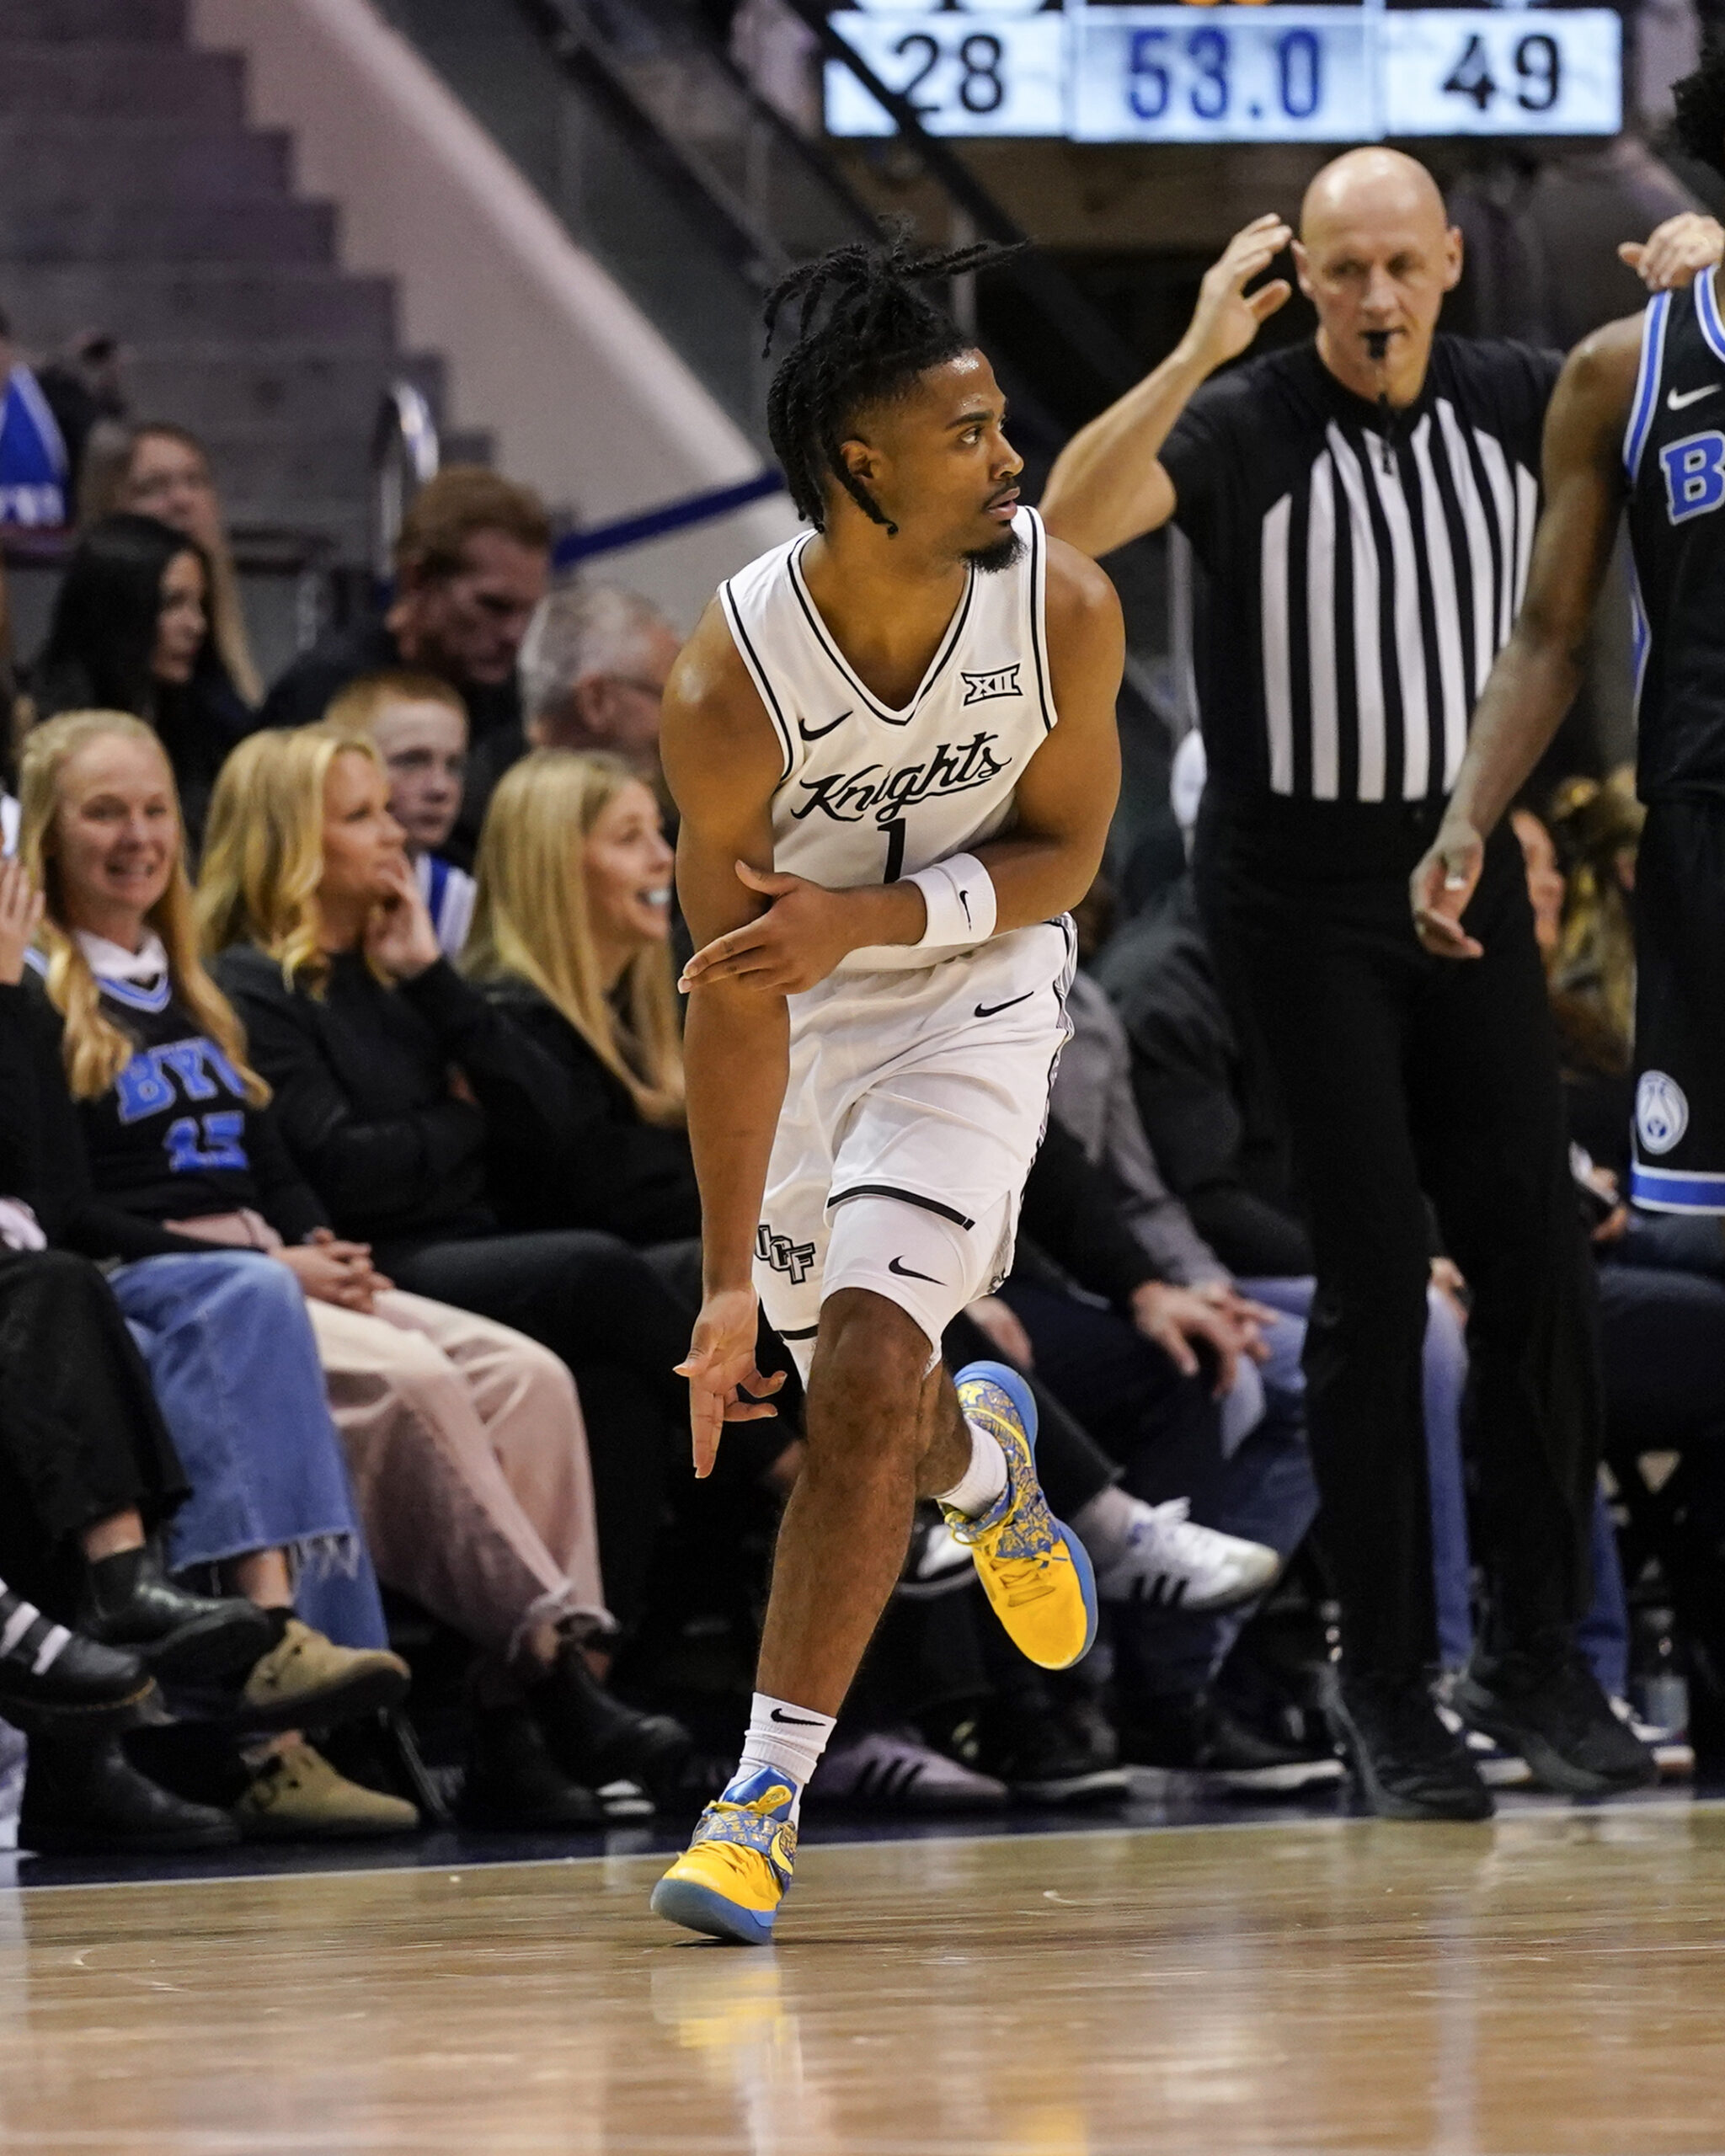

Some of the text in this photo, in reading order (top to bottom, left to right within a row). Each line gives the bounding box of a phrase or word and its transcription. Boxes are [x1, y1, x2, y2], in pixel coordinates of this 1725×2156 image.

[895, 29, 1561, 120] 28 53.0 49
[791, 732, 1012, 822] Knights
[877, 818, 905, 884] 1
